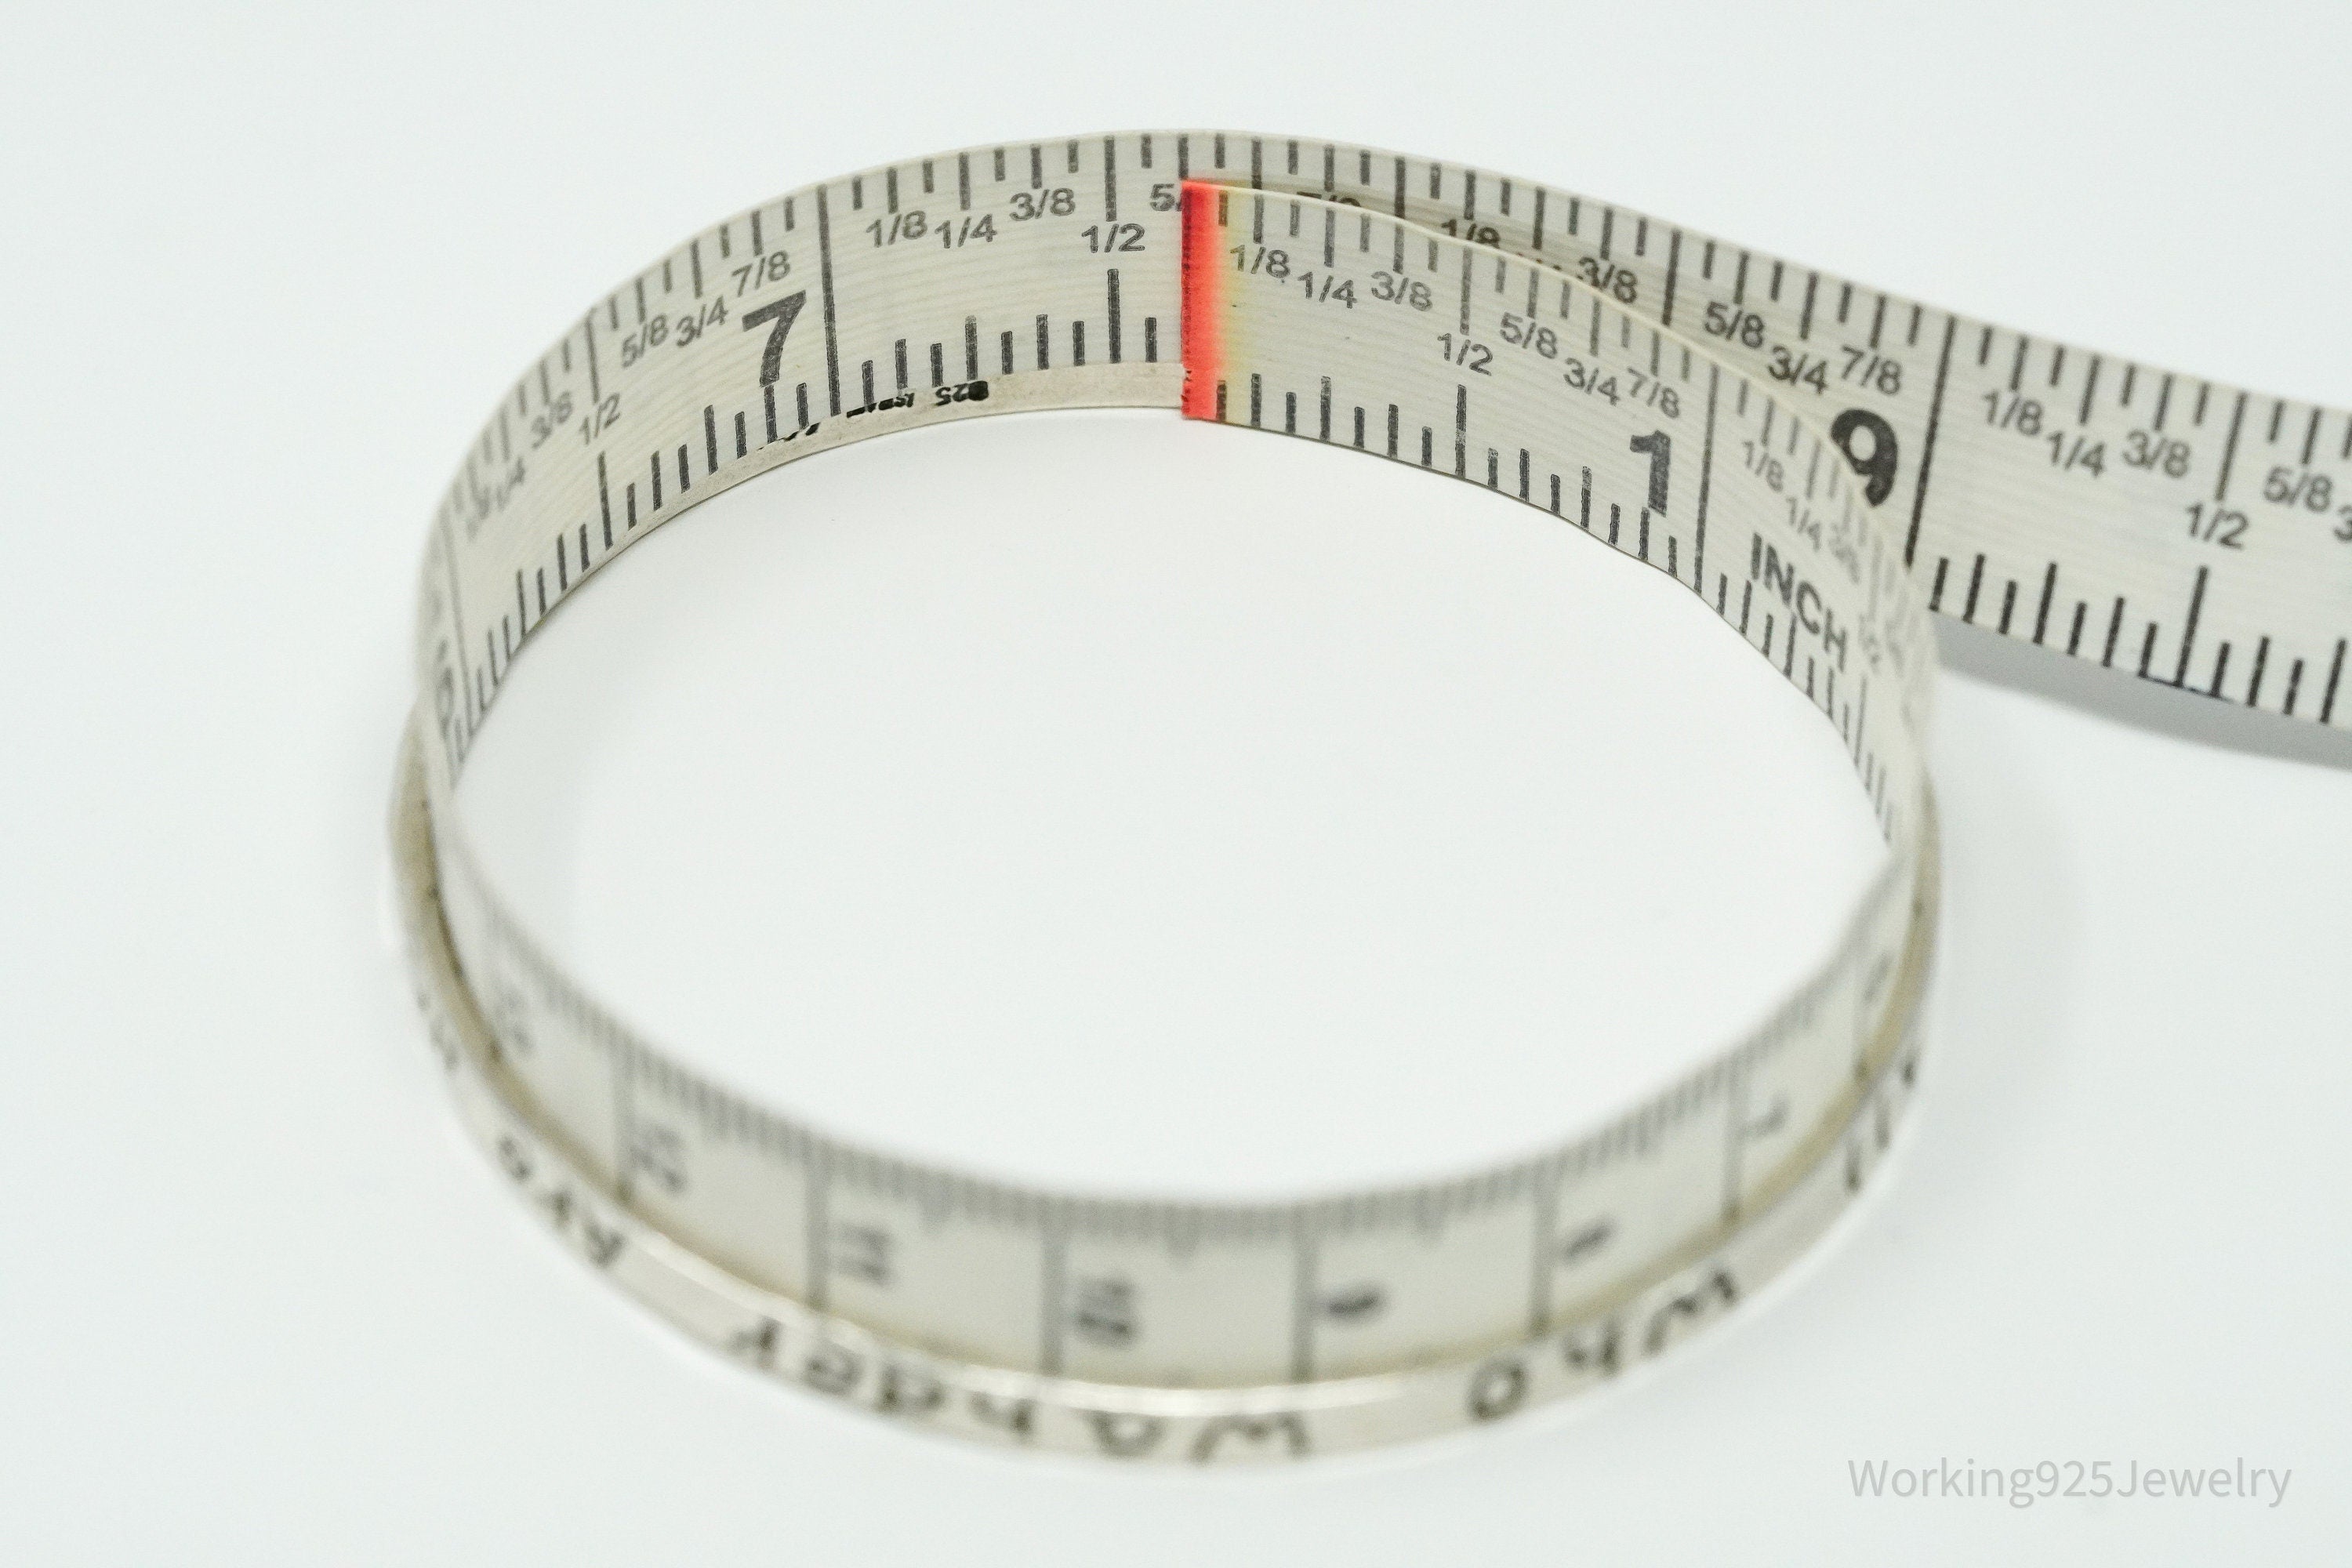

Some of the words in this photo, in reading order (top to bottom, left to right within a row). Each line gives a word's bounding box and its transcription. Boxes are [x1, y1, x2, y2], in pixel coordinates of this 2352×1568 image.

[866, 210, 928, 249] 1/8
[934, 213, 997, 249] 1/4
[1009, 187, 1076, 222] 3/8
[1081, 223, 1146, 253] 1/2
[579, 394, 621, 445] 1/2
[622, 314, 669, 369] 5/8
[677, 296, 728, 348] 3/4
[731, 250, 791, 298] 7/8
[742, 289, 807, 389] 7
[1230, 245, 1290, 279] 1/8
[1298, 271, 1358, 310] 1/4
[1370, 270, 1433, 311] 3/8
[1437, 332, 1494, 378] 1/2
[1499, 313, 1559, 361] 5/8
[1563, 356, 1621, 408] 3/4
[1626, 366, 1681, 419] 7/8
[1703, 300, 1766, 350] 5/8
[1766, 344, 1829, 395] 3/4
[1839, 345, 1904, 397] 7/8
[1629, 429, 1671, 518] 1
[1741, 440, 1784, 493] 1/8
[1829, 408, 1899, 509] 9
[1980, 388, 2044, 438] 1/8
[2045, 429, 2106, 478] 1/4
[2121, 428, 2191, 478] 3/8
[2187, 501, 2249, 551] 1/2
[2263, 465, 2333, 514] 5/8
[1750, 532, 1846, 673] INCH
